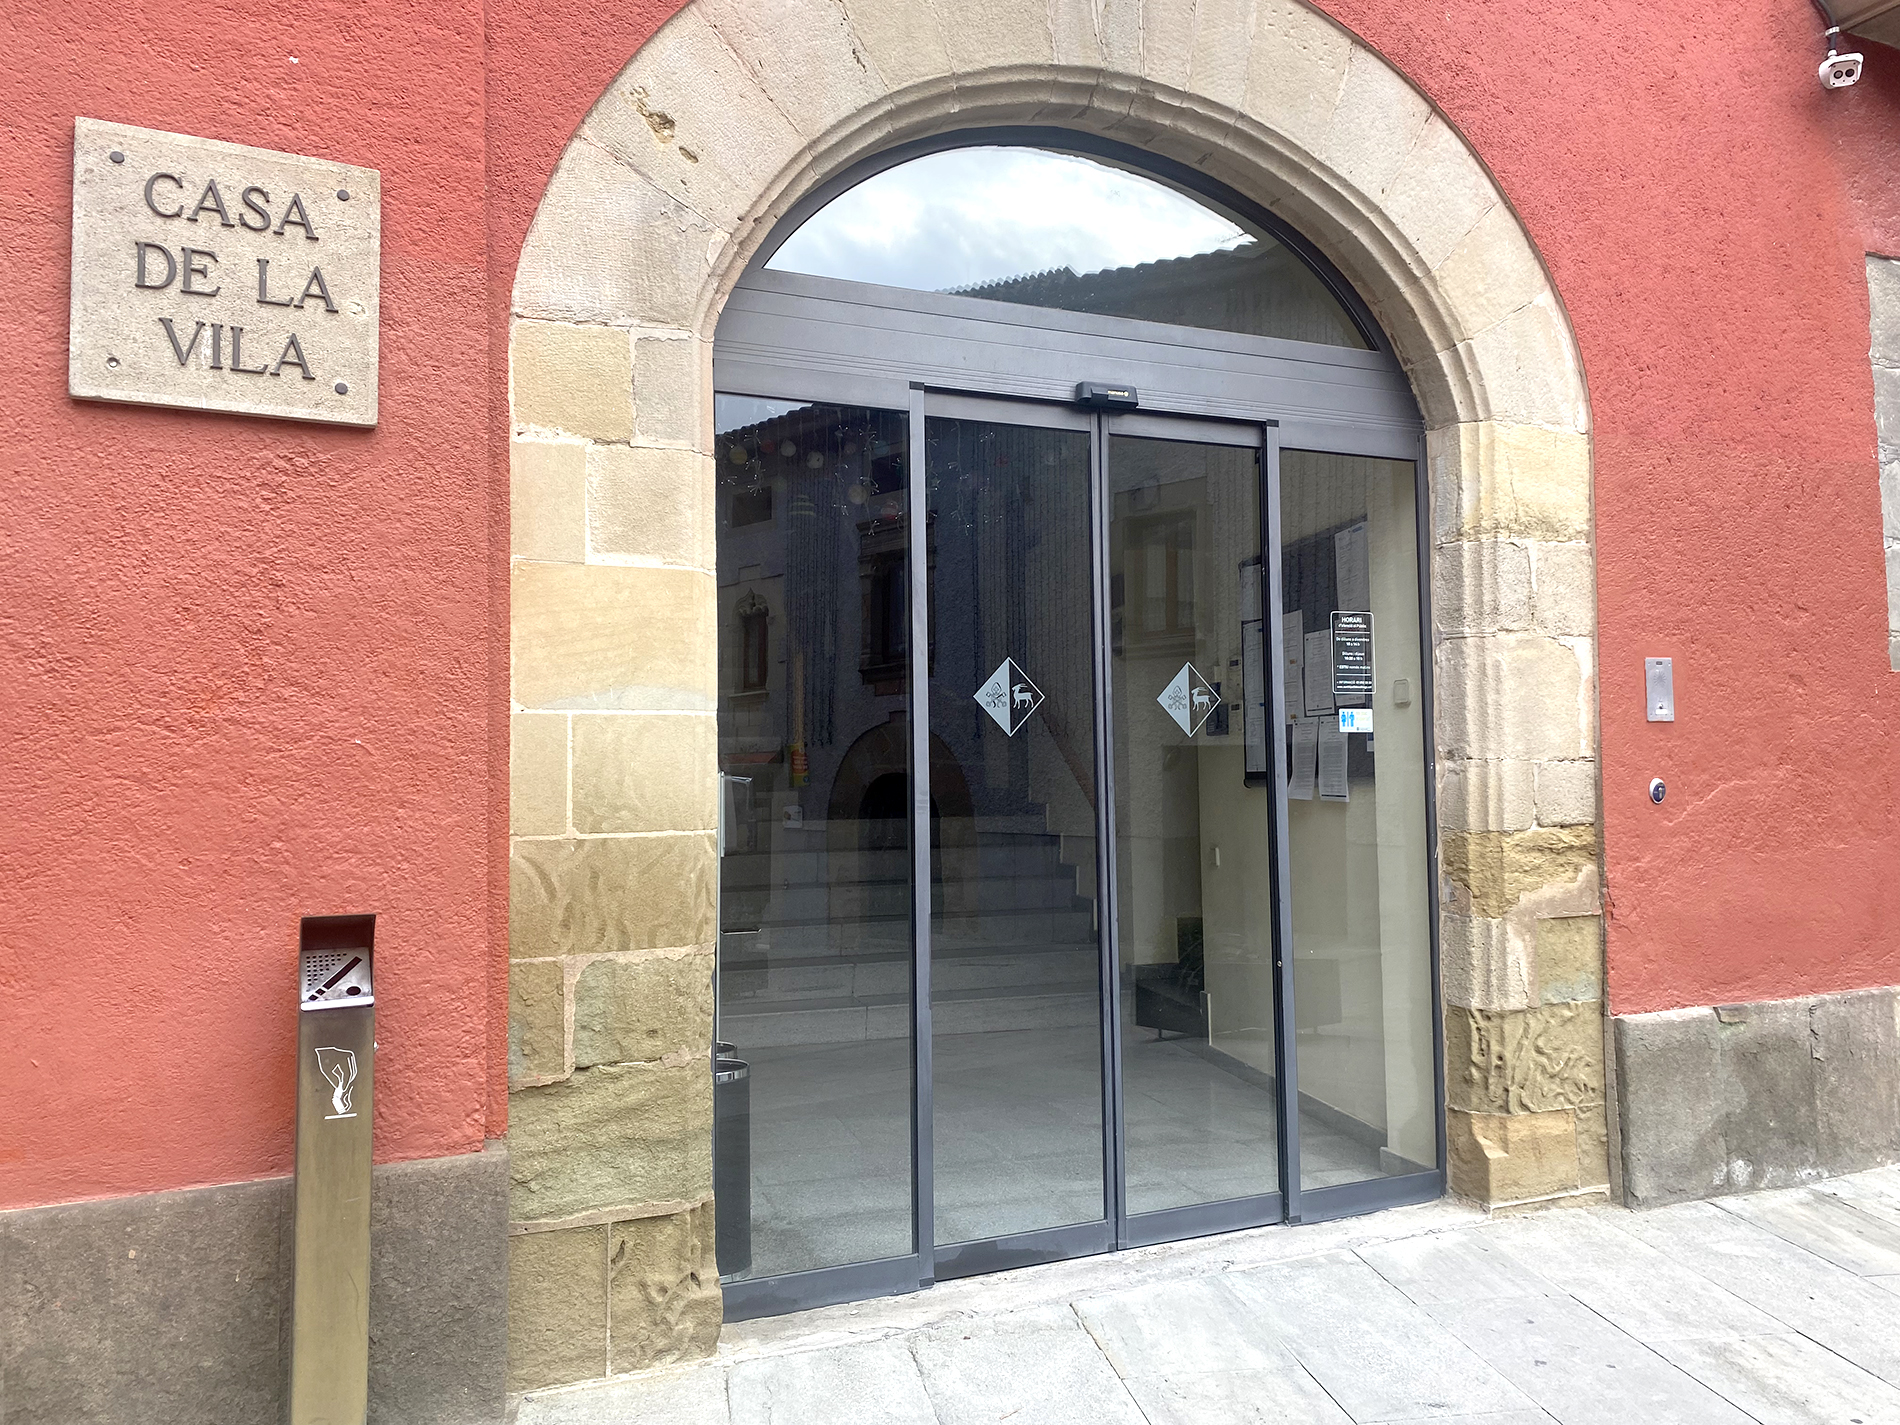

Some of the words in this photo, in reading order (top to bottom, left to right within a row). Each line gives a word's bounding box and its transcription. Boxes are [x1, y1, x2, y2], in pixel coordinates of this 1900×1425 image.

[144, 172, 319, 241] CASA
[135, 241, 221, 297] DE
[256, 258, 339, 313] LA
[158, 317, 316, 380] VILA
